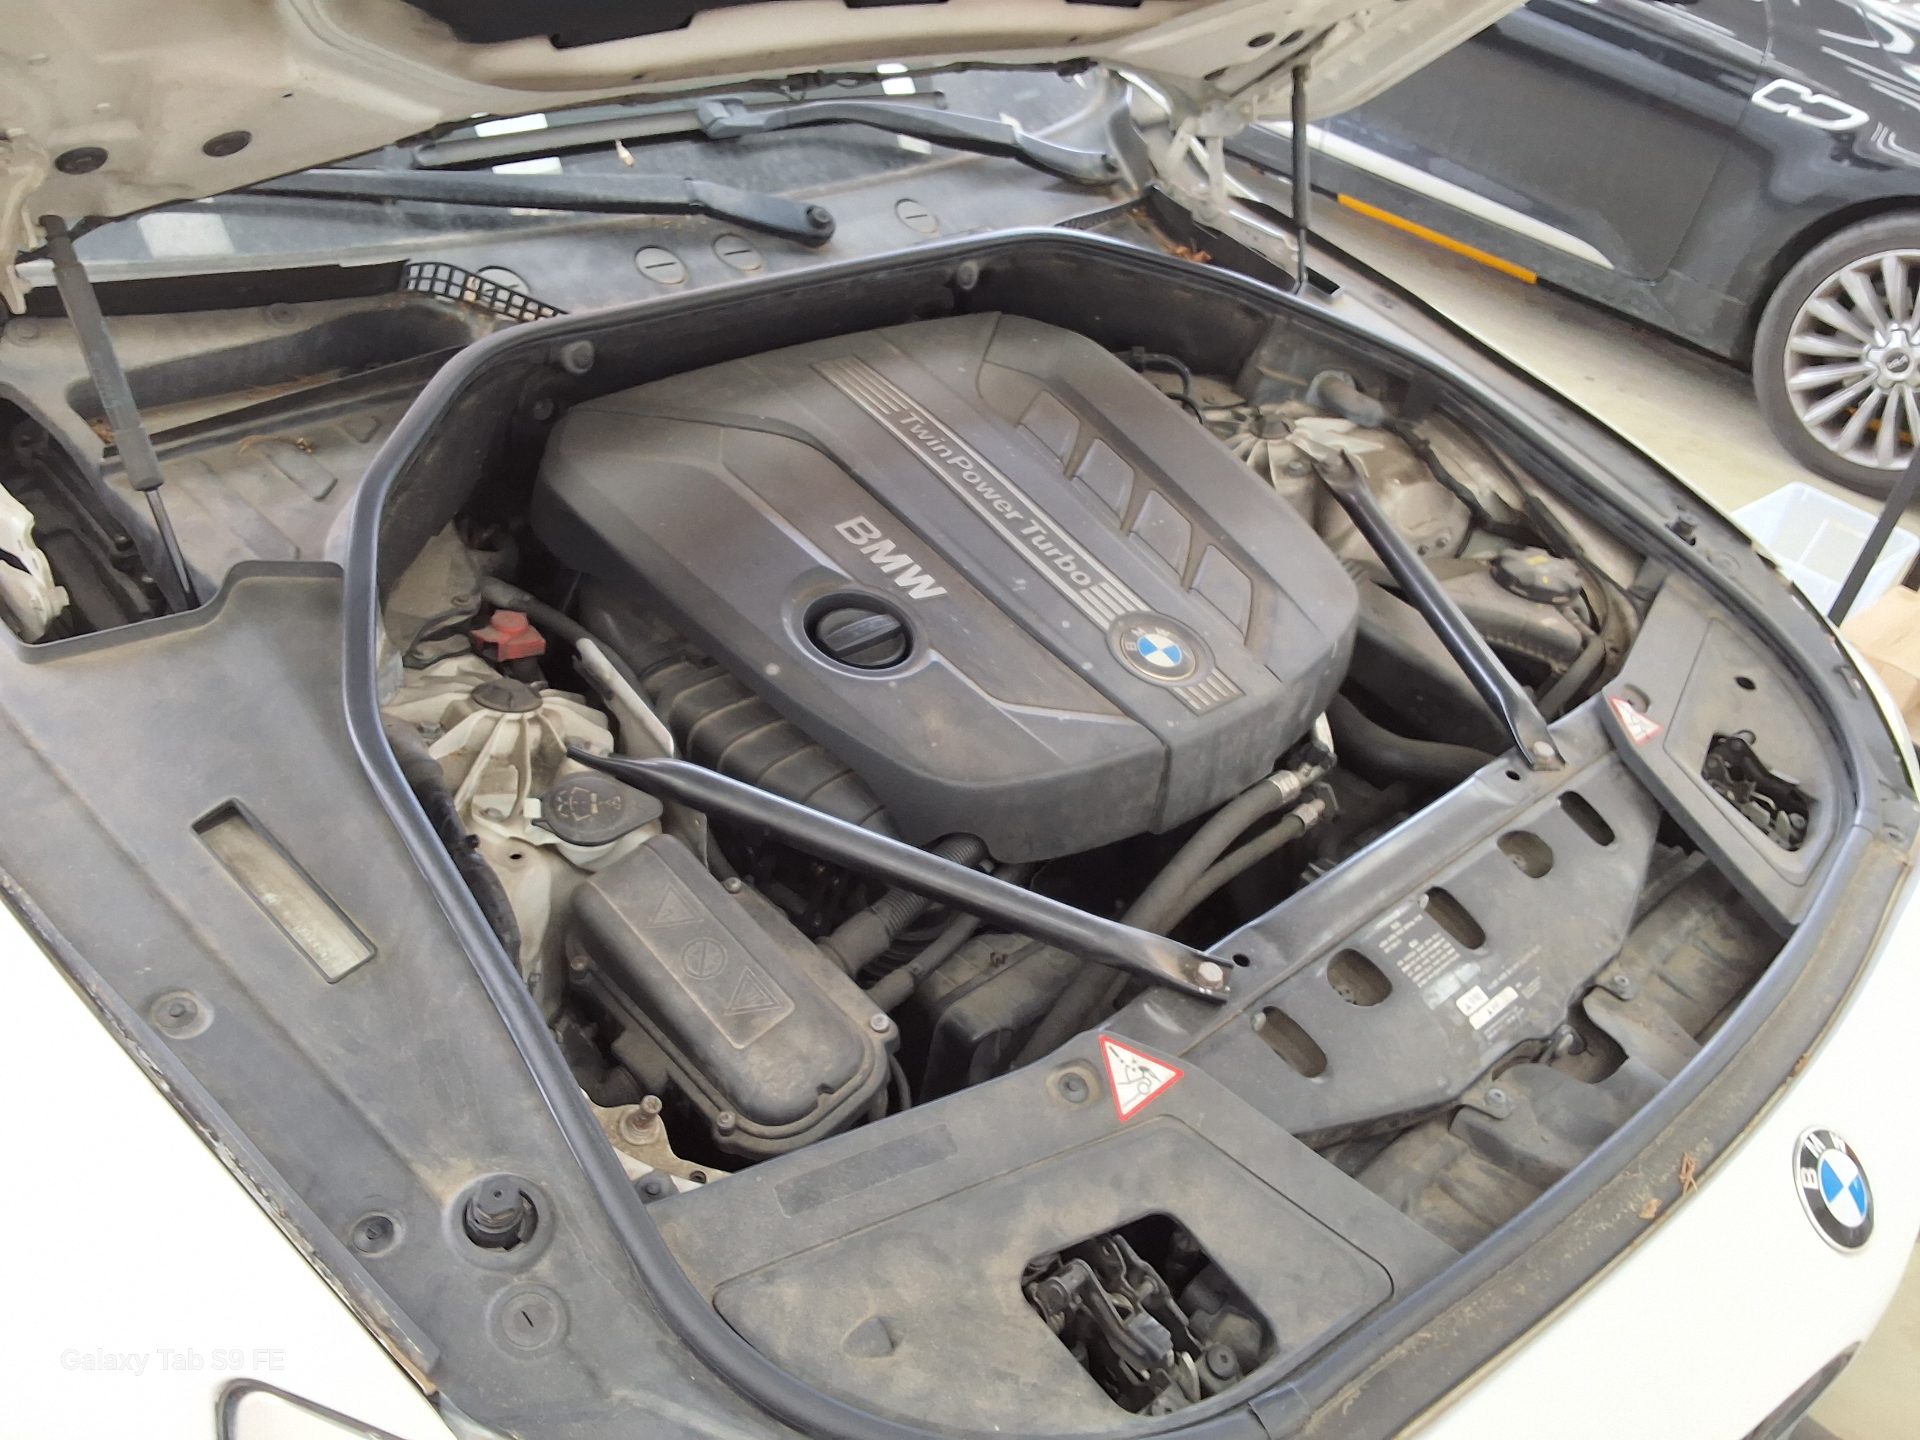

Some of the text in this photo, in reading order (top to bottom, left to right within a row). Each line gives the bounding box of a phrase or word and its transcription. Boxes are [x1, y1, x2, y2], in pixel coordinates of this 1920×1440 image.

[834, 515, 947, 599] BMW
[1020, 519, 1091, 586] Turbo
[1800, 1131, 1847, 1190] BMW
